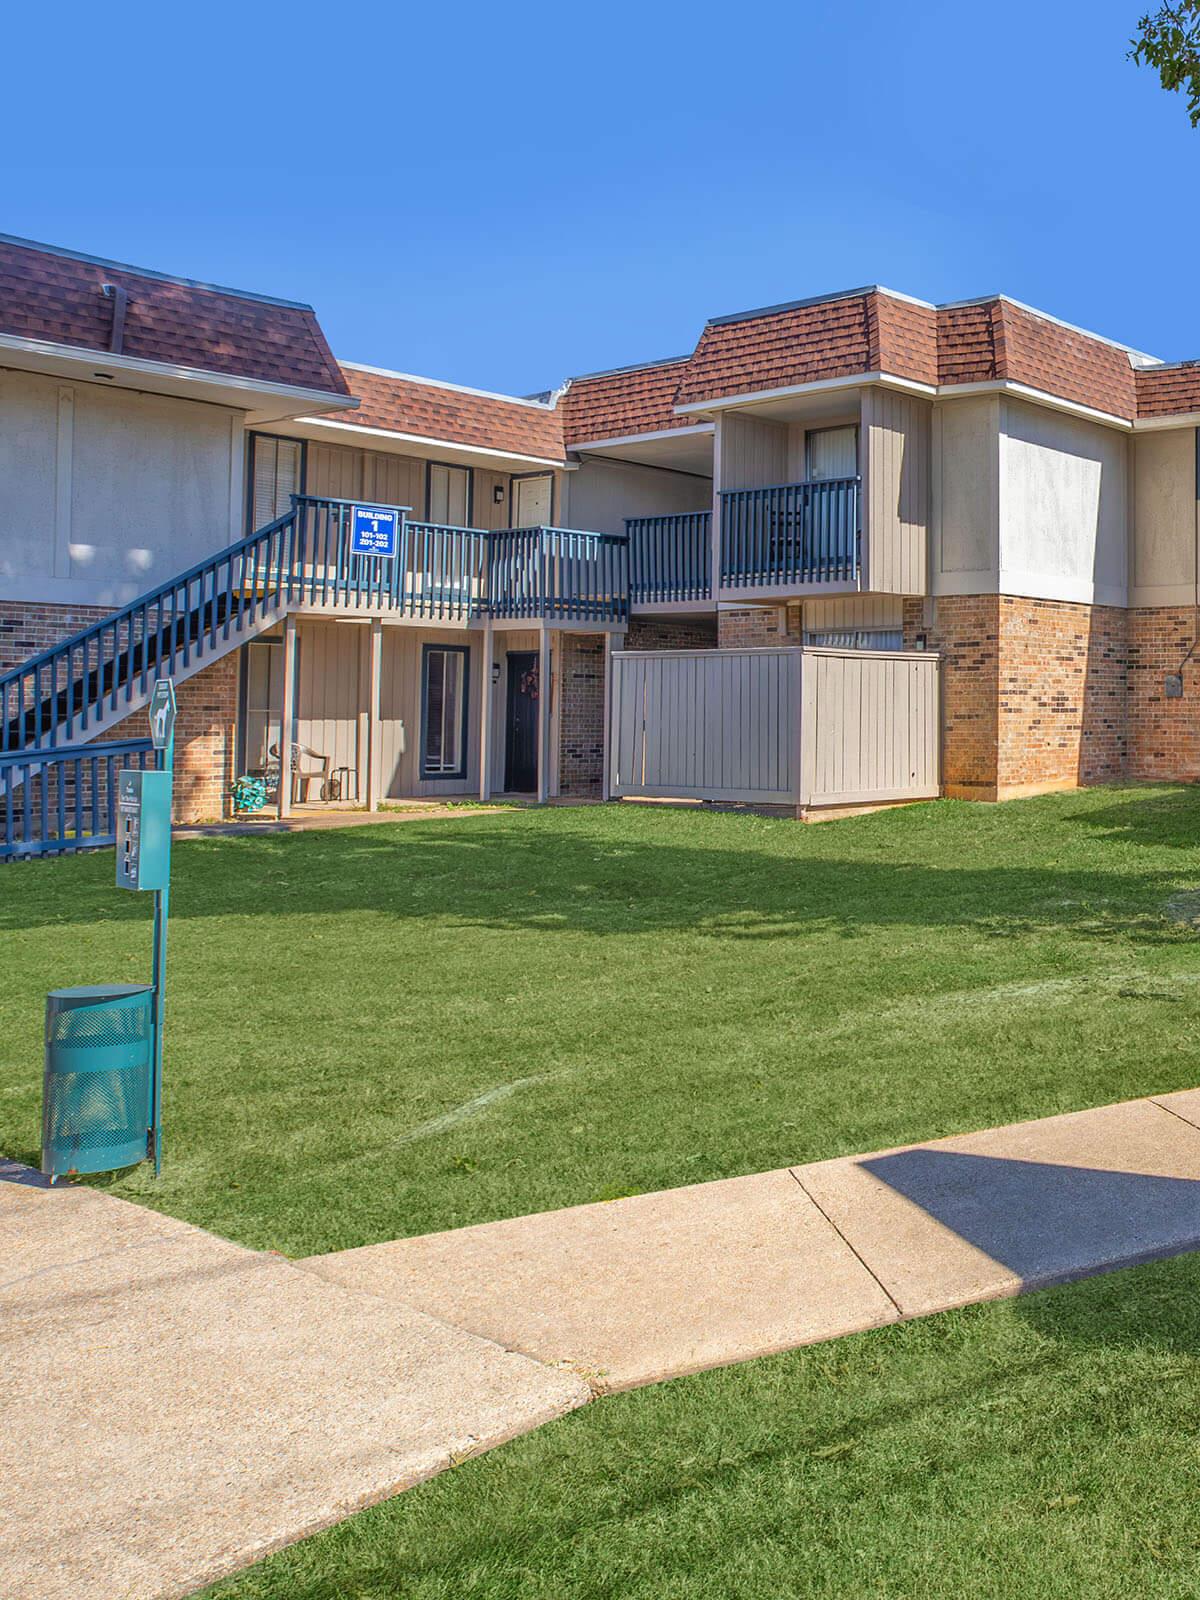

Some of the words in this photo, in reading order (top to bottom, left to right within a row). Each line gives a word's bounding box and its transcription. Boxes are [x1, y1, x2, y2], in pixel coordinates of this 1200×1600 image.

[357, 511, 393, 521] BUILDING
[371, 520, 378, 532] 1
[361, 531, 388, 540] 101-102
